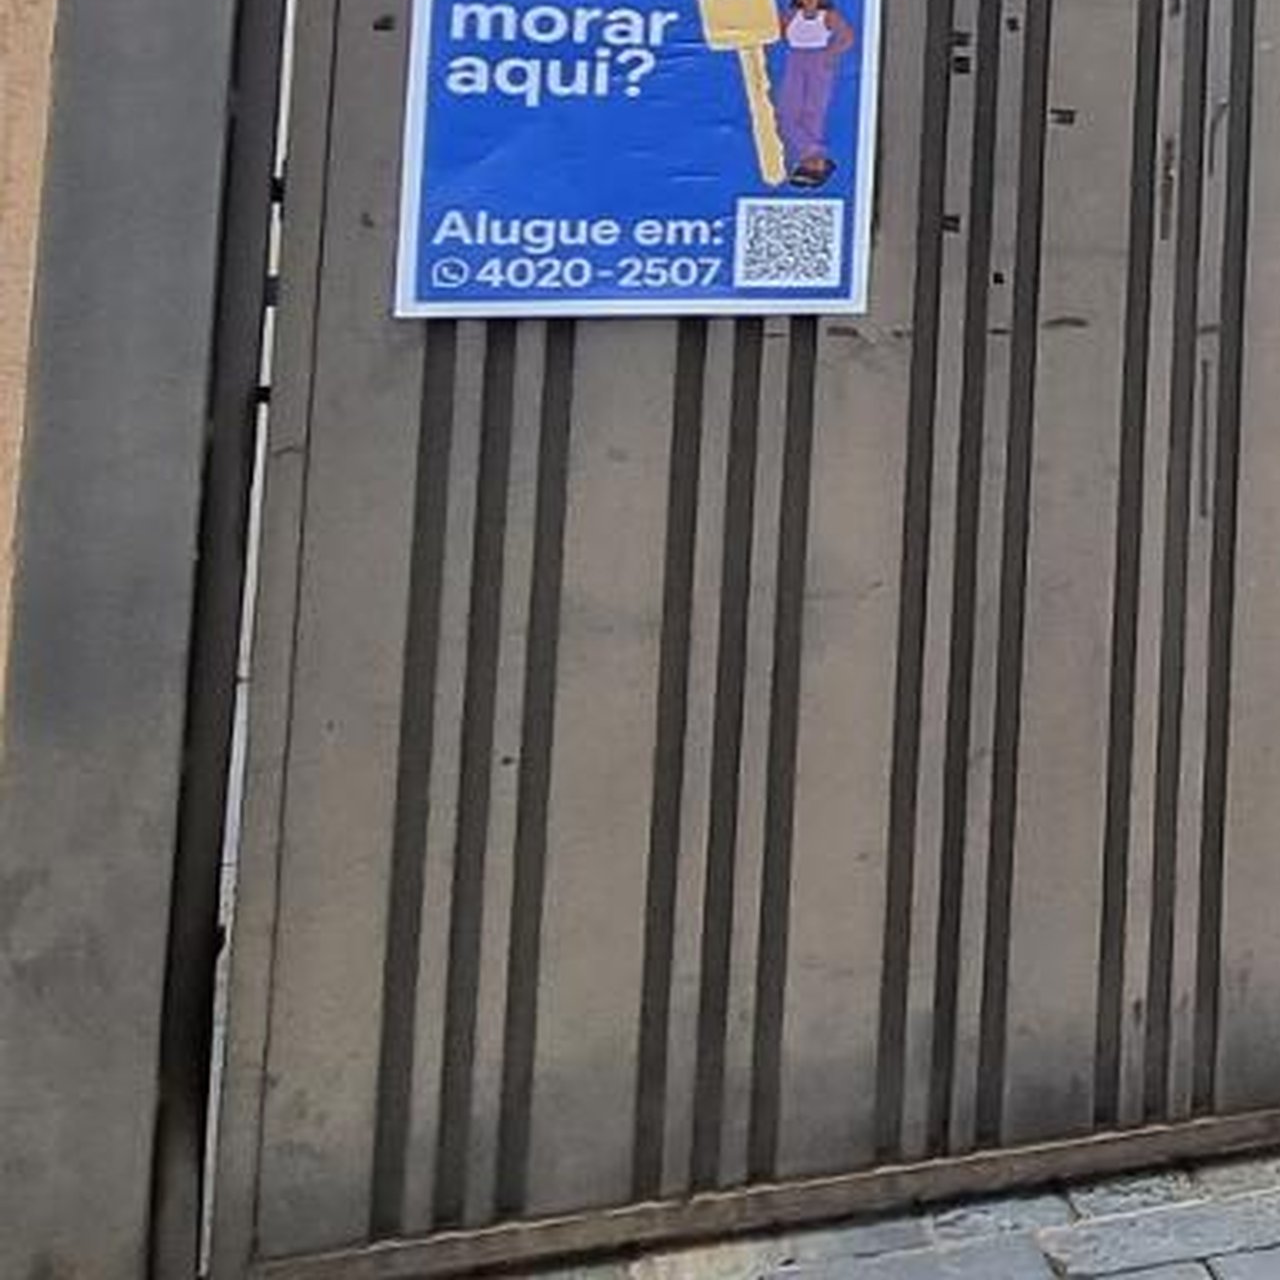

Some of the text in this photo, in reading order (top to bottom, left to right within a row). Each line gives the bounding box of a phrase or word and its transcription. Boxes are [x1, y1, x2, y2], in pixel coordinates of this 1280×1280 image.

[449, 0, 680, 47] morar
[444, 46, 657, 108] aqui?
[432, 209, 725, 254] Alugue em:
[474, 256, 723, 289] 4020-2507
